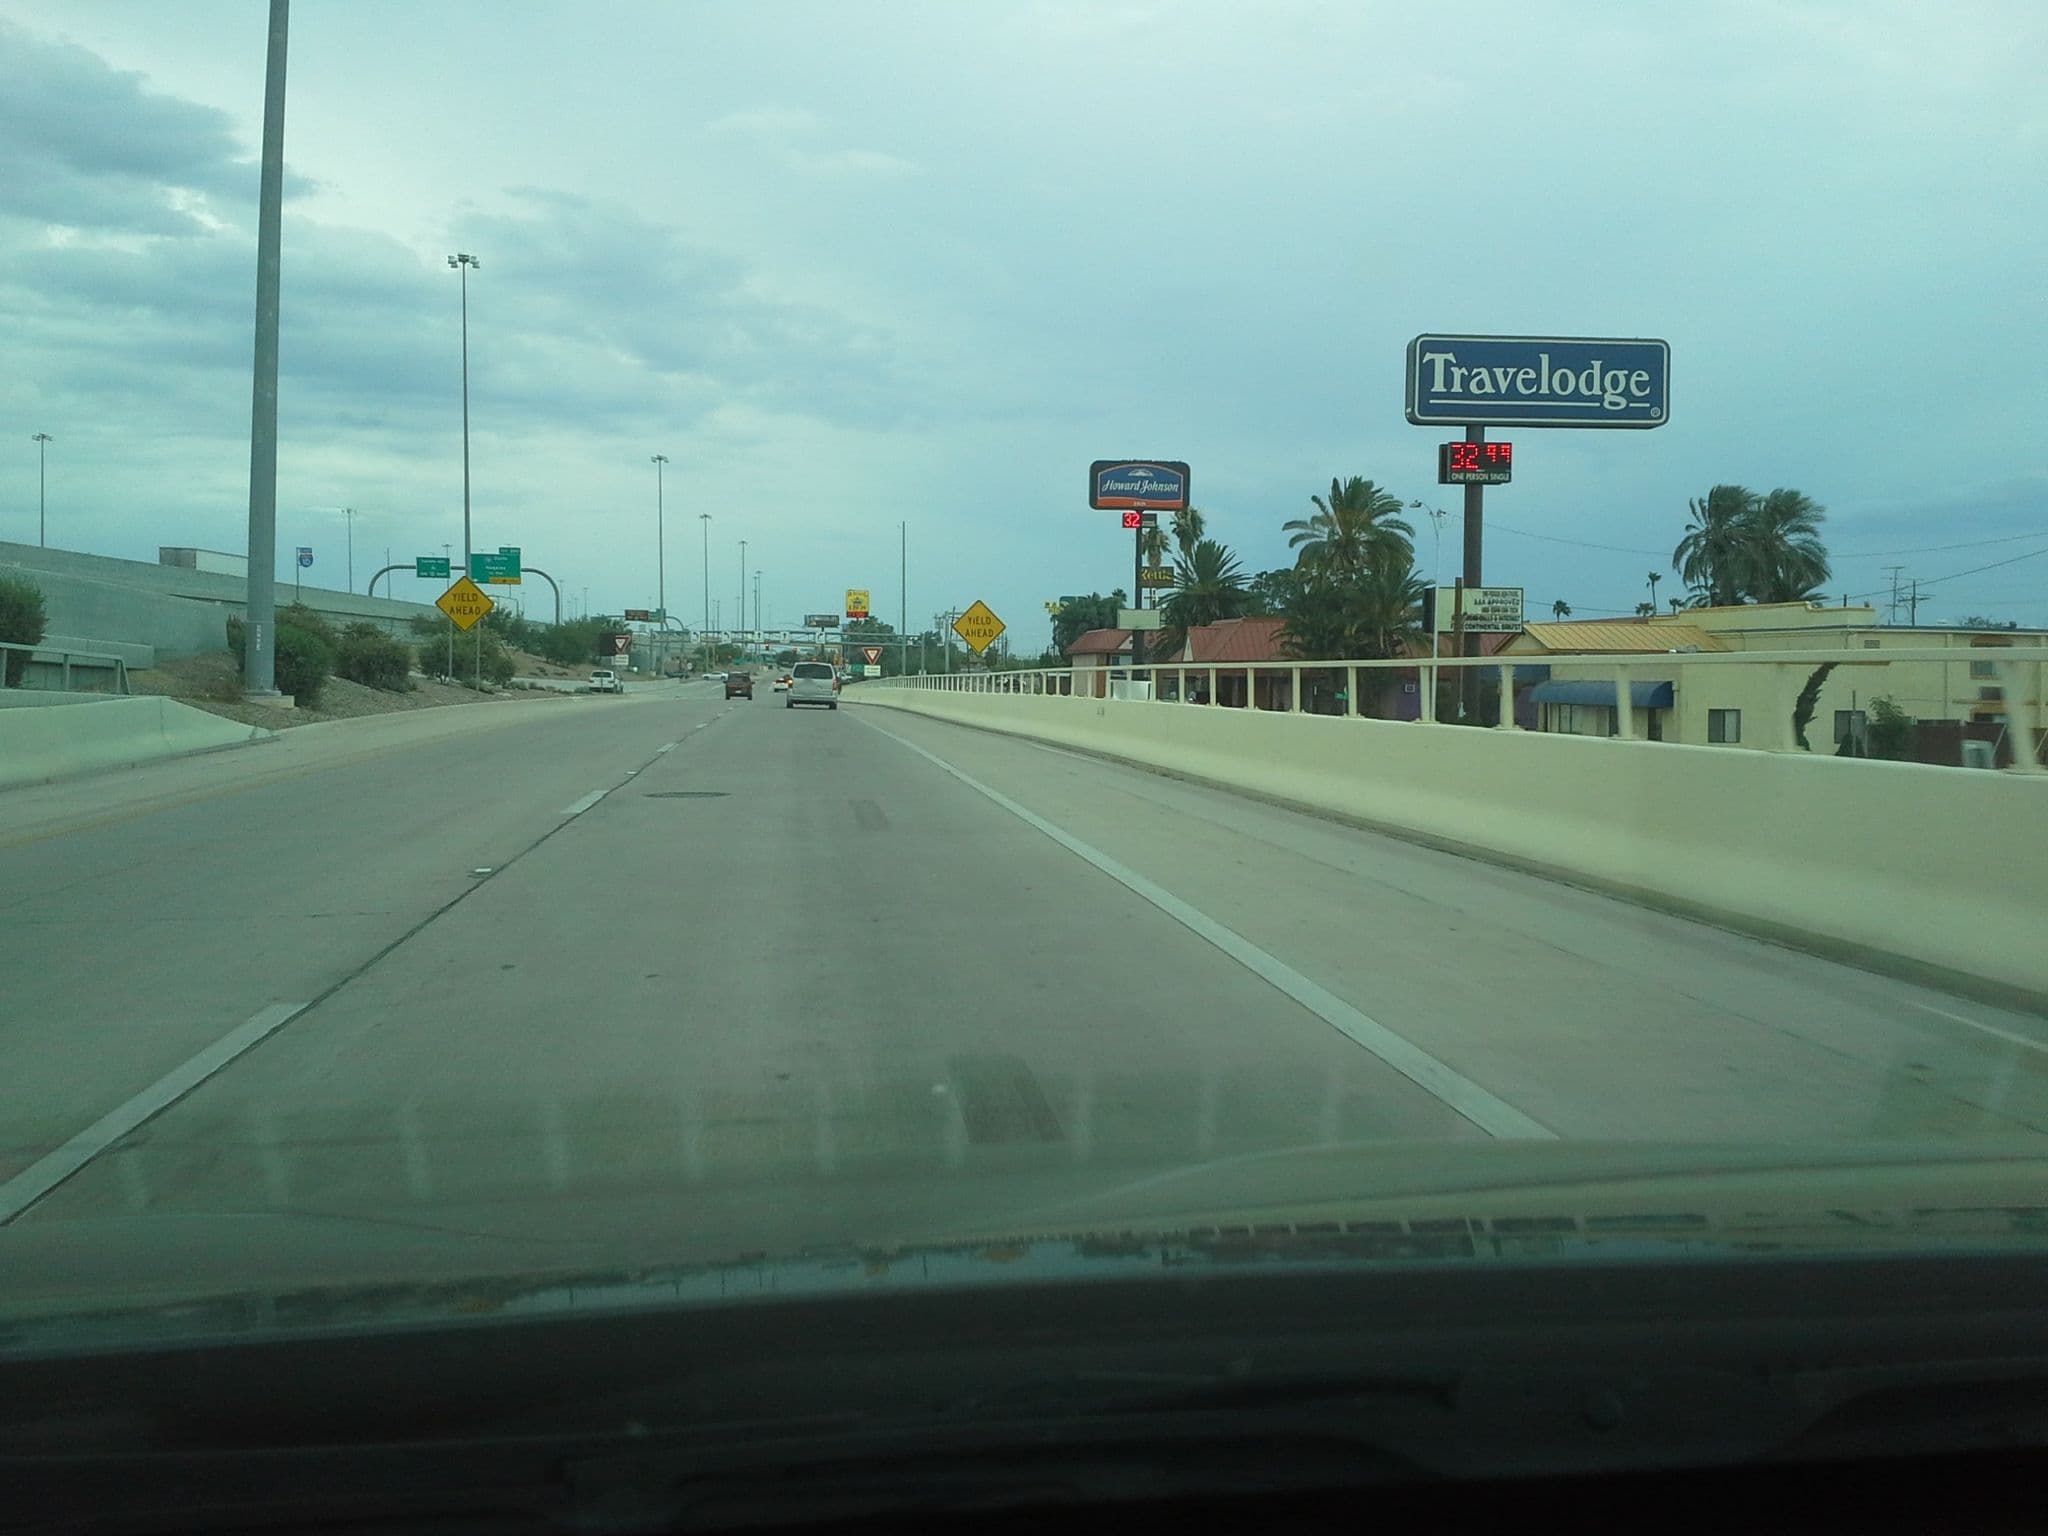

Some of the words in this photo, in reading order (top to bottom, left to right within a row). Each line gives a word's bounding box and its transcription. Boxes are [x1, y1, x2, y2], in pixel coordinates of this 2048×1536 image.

[1423, 352, 1651, 411] Travelodge
[1451, 444, 1479, 469] 32
[1451, 473, 1465, 481] ONE
[1466, 473, 1489, 481] PERSON
[1490, 473, 1510, 481] SINGLE
[1102, 480, 1140, 492] Howard
[1139, 480, 1179, 494] Johnson
[1123, 513, 1140, 527] 32
[452, 592, 478, 602] YIELD
[449, 604, 481, 615] AHEAD
[968, 615, 992, 626] YIELD
[965, 628, 994, 638] AHEAD
